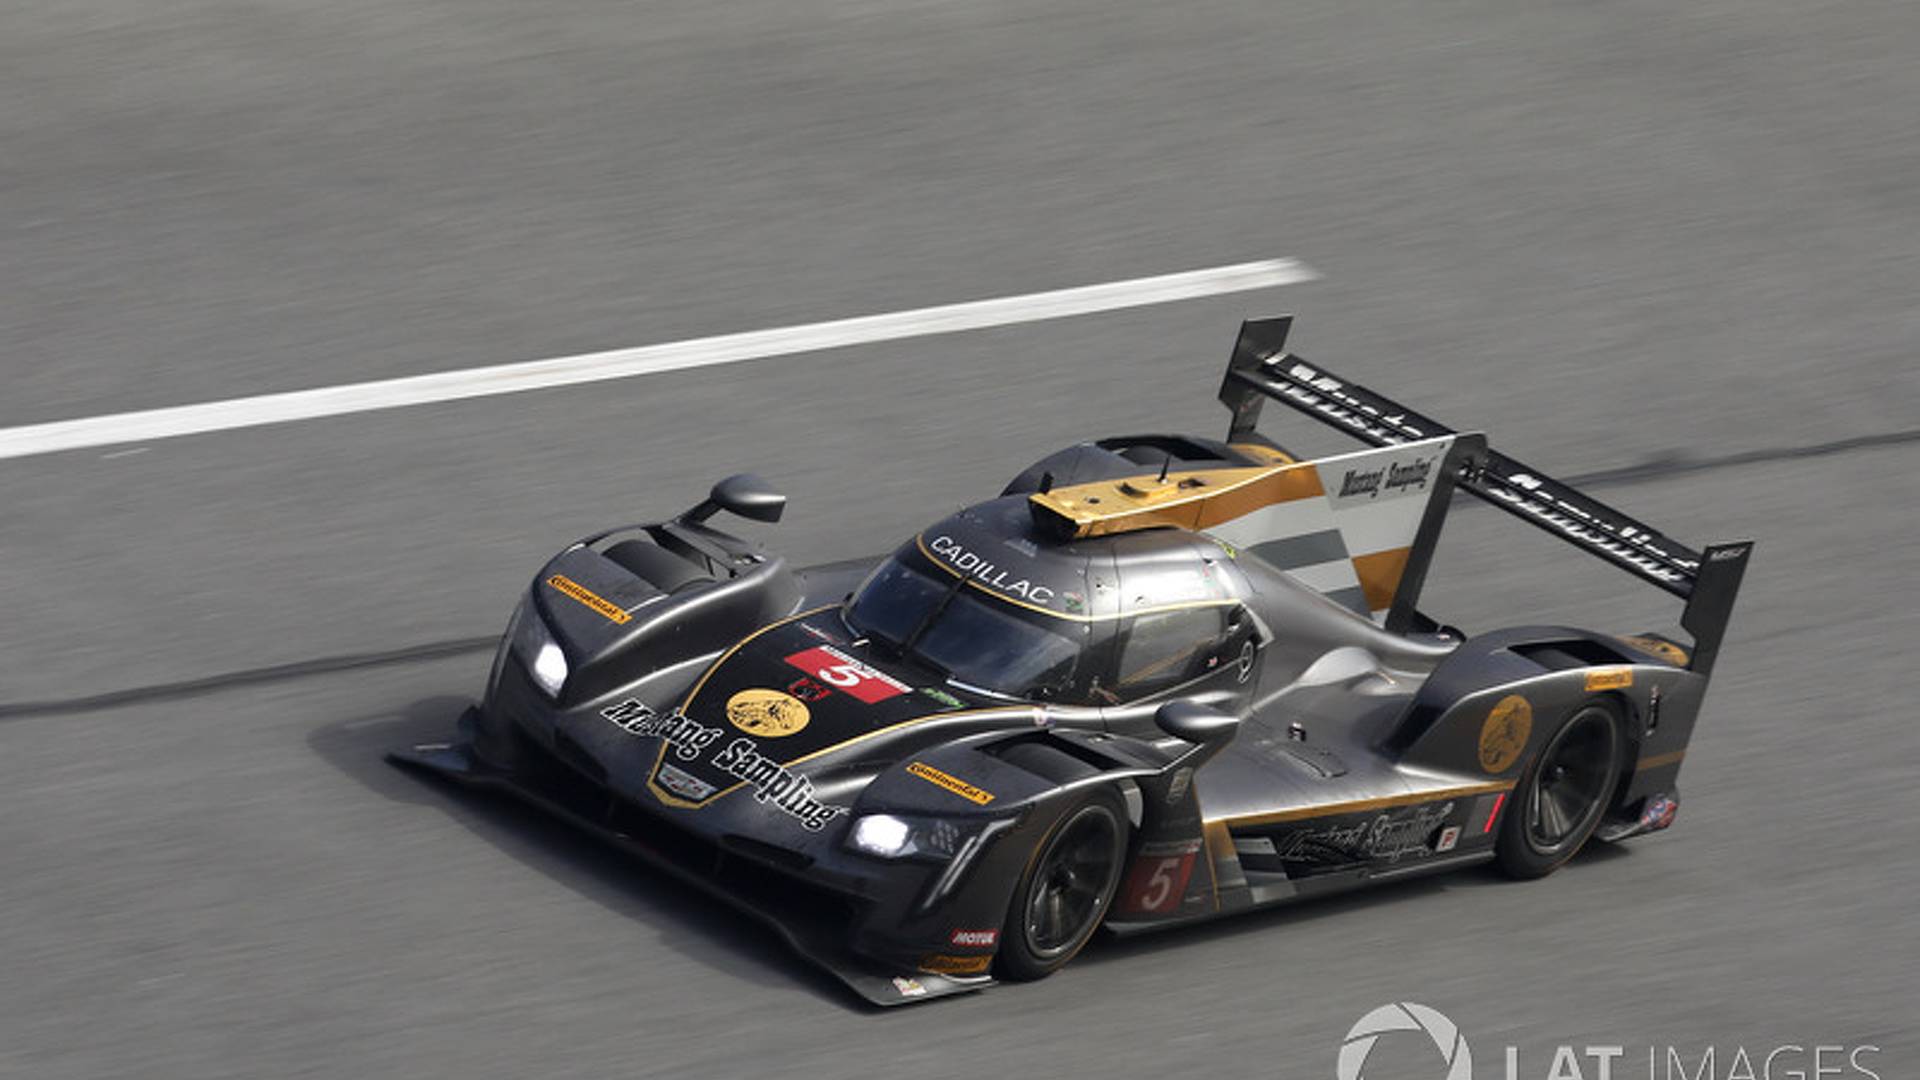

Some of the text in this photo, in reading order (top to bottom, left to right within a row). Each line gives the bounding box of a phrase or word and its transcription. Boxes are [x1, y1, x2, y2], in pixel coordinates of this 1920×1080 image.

[931, 536, 1054, 604] CADILLAC
[818, 663, 877, 687] 5
[711, 738, 849, 832] Sampling
[1141, 857, 1180, 910] 5
[952, 931, 995, 944] MOTUL
